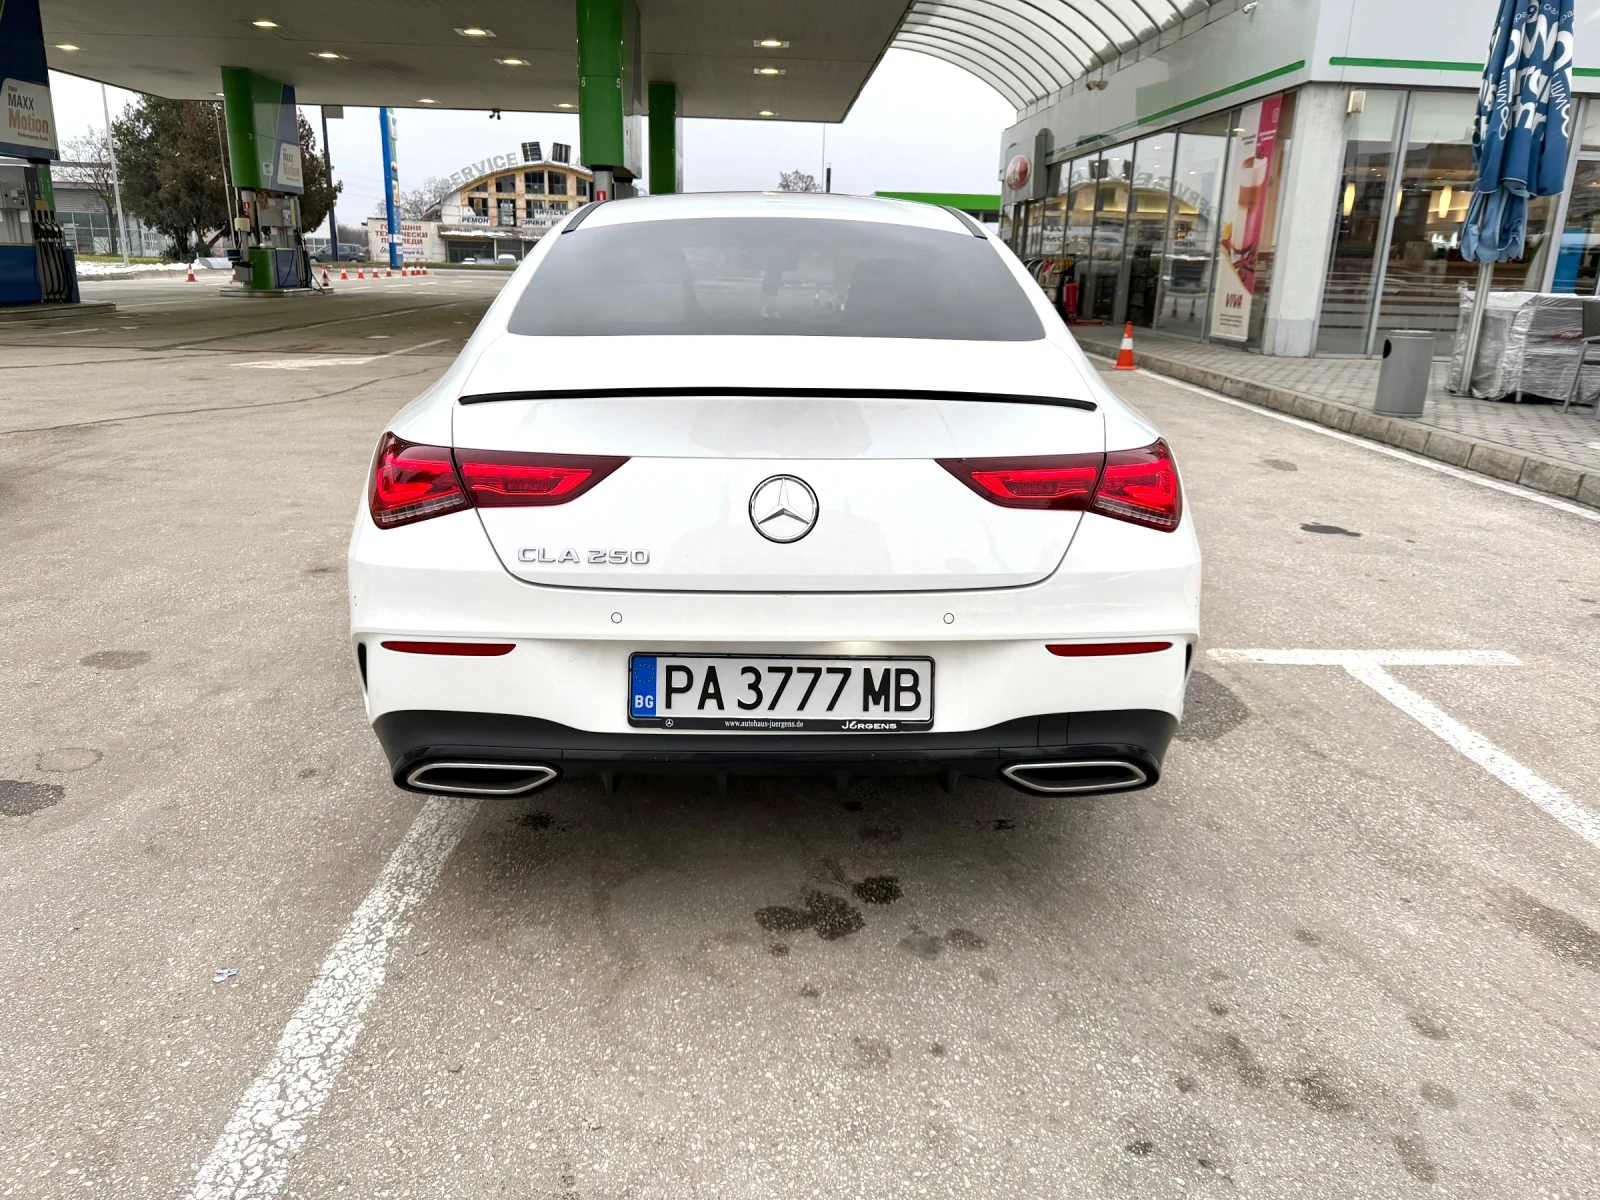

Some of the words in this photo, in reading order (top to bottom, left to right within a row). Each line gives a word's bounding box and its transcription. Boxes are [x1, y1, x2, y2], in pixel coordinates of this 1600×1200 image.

[581, 76, 587, 88] 6
[616, 77, 621, 89] 5
[8, 93, 34, 111] MAXX
[9, 108, 48, 134] Motion
[248, 132, 253, 140] 3
[1225, 293, 1243, 309] VIVA
[518, 546, 580, 563] CLA
[587, 548, 650, 564] 250
[664, 665, 725, 711] PA
[737, 666, 852, 712] 3777
[862, 667, 922, 712] MB
[634, 695, 654, 709] BG
[724, 719, 804, 729] www.autohaus-juergens.de
